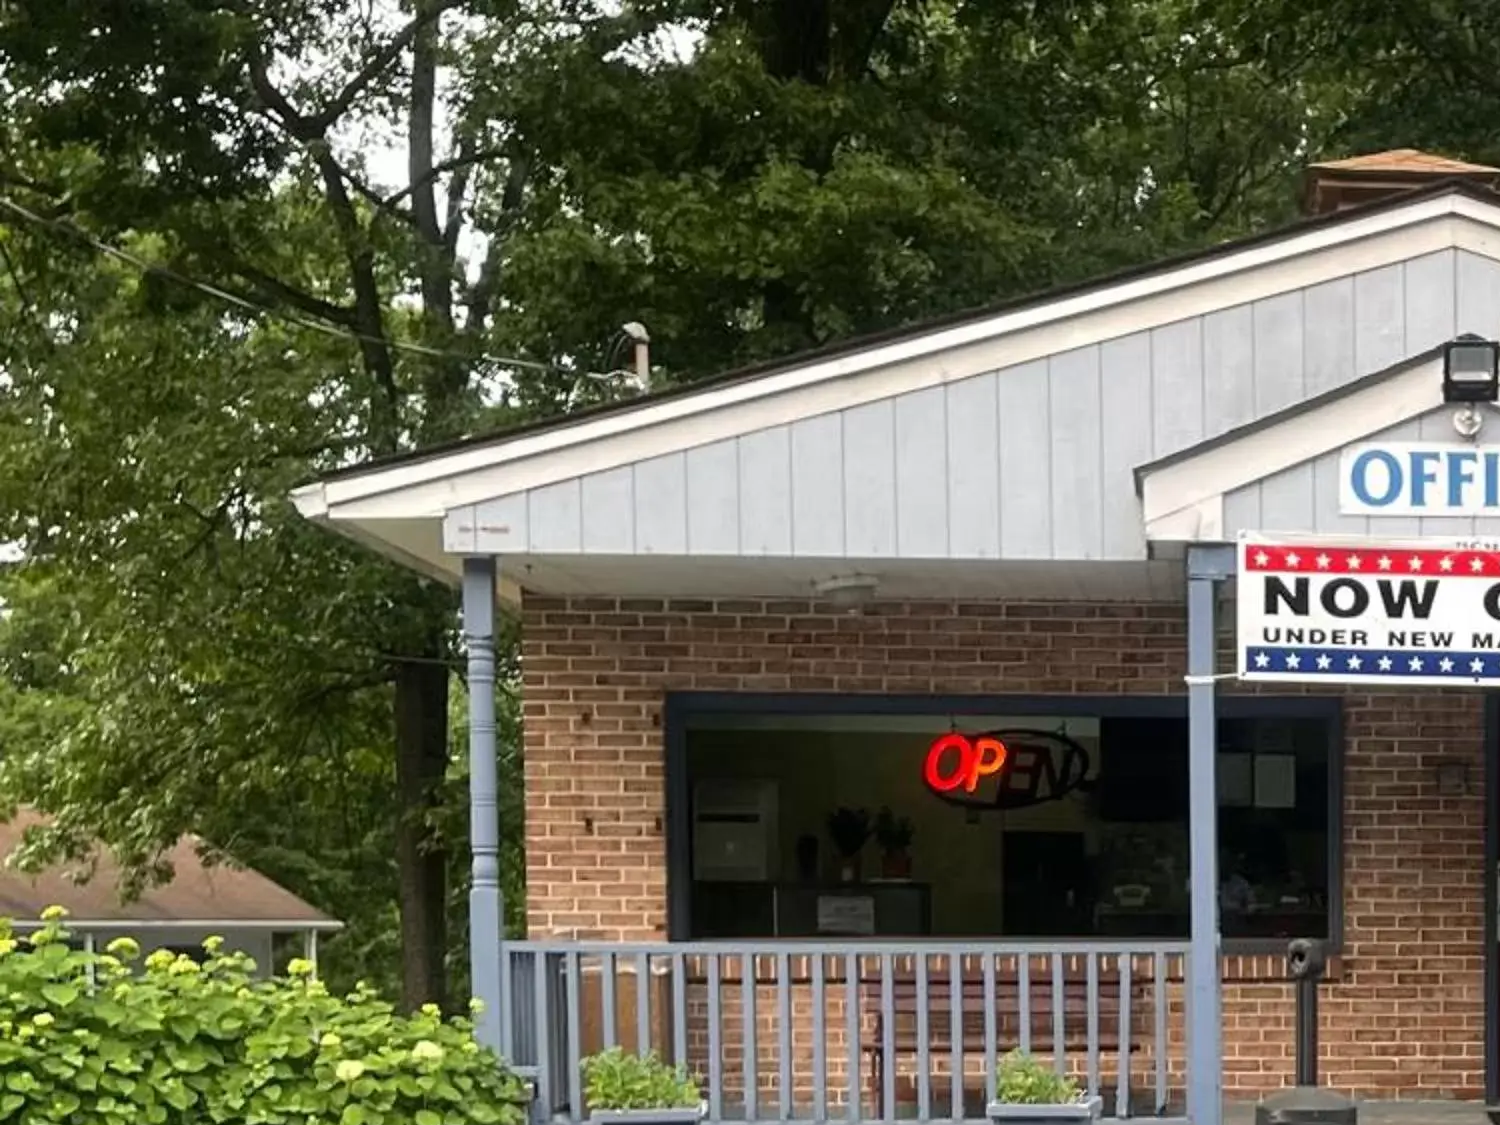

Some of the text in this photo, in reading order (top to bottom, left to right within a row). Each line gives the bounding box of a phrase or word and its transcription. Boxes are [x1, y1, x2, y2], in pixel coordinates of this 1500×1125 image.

[1263, 575, 1440, 620] NOW
[1263, 627, 1368, 646] UNDER
[1388, 631, 1454, 648] NEW
[923, 733, 1083, 803] OPEN
